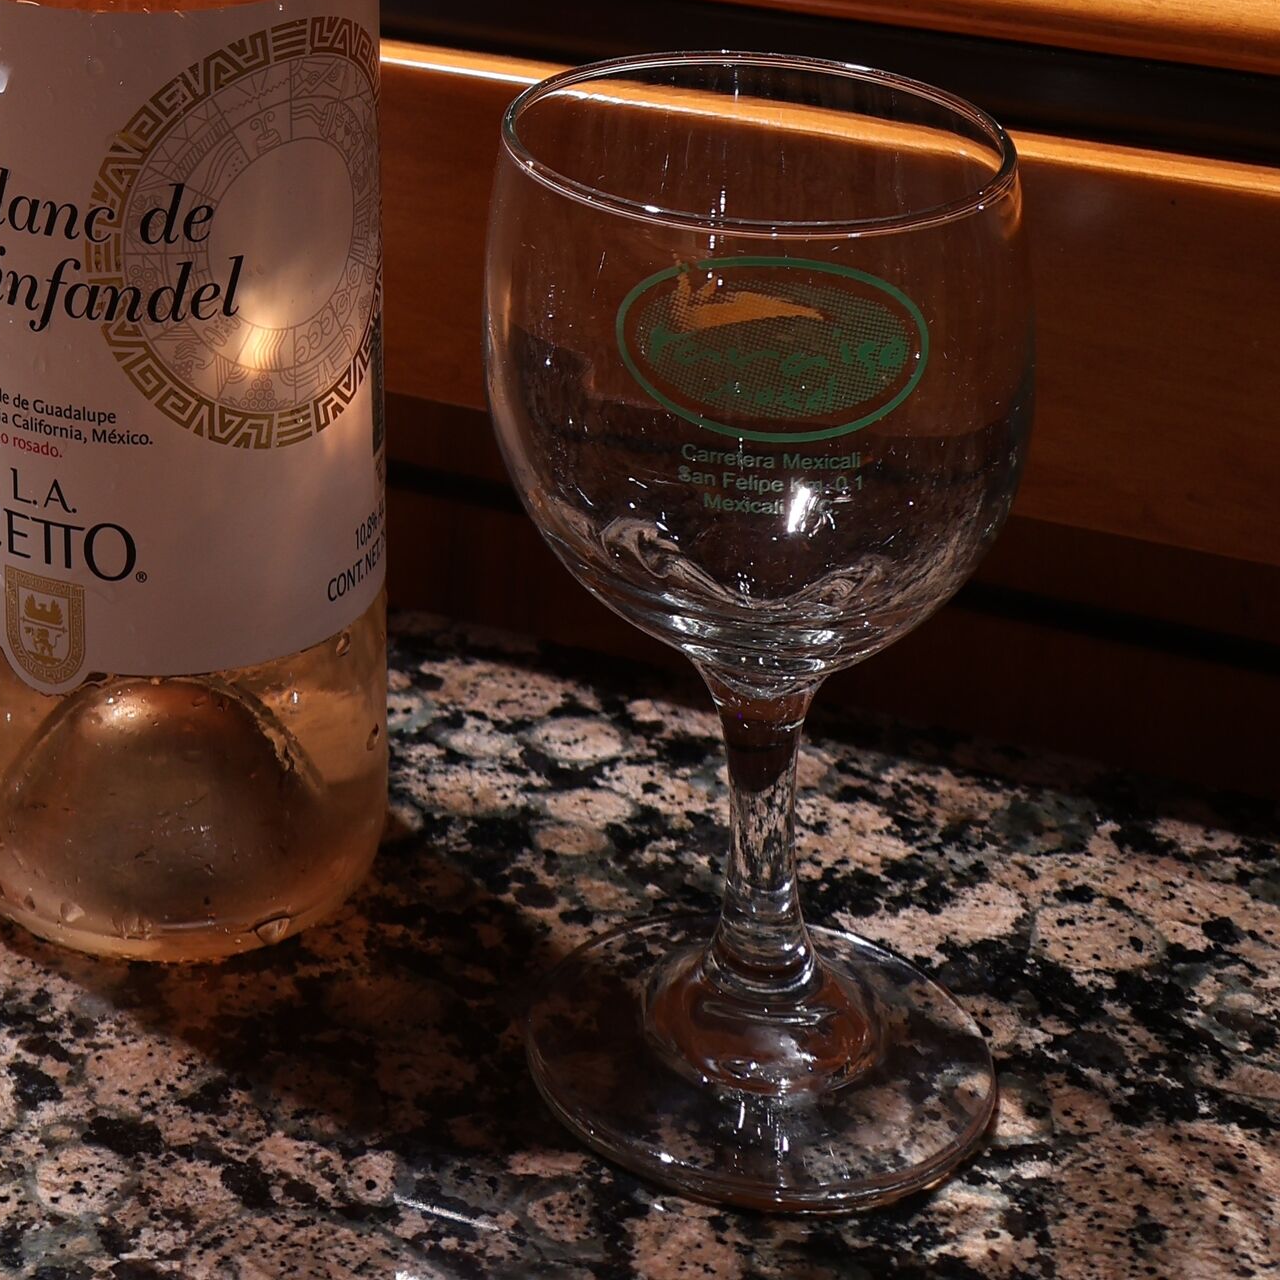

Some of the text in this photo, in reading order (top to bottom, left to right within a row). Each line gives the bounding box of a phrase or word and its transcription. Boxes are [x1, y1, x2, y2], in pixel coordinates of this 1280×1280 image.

[139, 182, 215, 245] de
[13, 393, 29, 411] de
[33, 399, 117, 425] Guadalupe
[12, 413, 88, 443] California,
[91, 426, 154, 446] México.
[12, 436, 63, 459] rosado.
[680, 443, 861, 470] Carretera Mexicali
[677, 464, 716, 487] San
[722, 471, 784, 495] Felipe
[703, 492, 784, 515] Mexicali
[327, 559, 364, 602] CONT.
